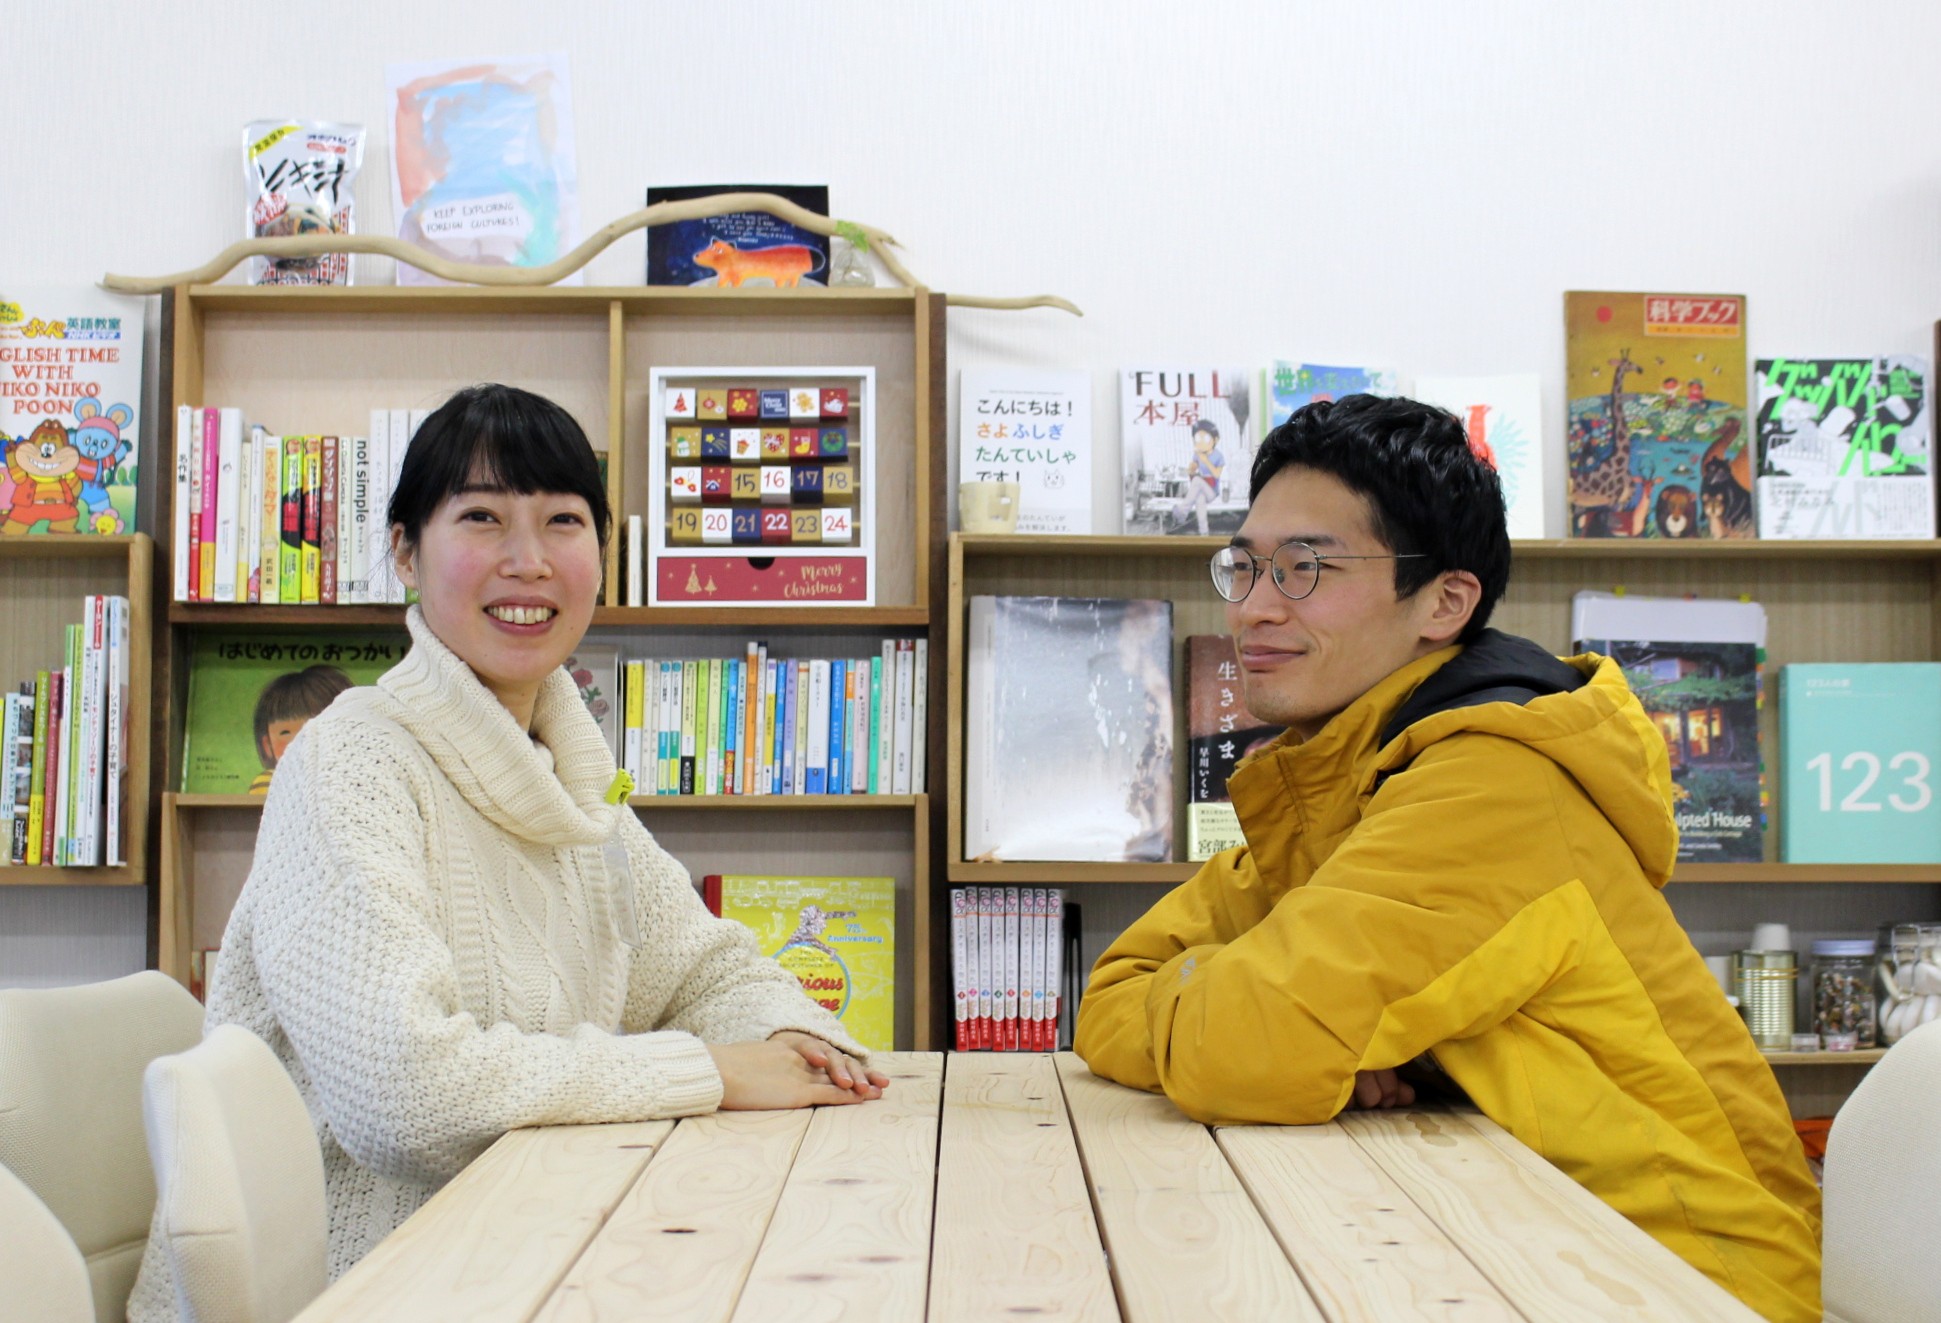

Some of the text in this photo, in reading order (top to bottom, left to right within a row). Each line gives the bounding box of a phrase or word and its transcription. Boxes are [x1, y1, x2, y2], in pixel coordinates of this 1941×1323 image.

[434, 202, 513, 218] KEEP EXPLORING
[427, 216, 519, 232] FOREIGN CULTURES!
[1651, 301, 1736, 322] 科学ブック
[0, 347, 119, 362] GLISH TIME
[12, 365, 73, 379] WITH
[0, 382, 100, 397] IKO NIKO
[1136, 370, 1232, 398] FULL
[13, 400, 73, 414] POON
[977, 399, 1073, 416] こんにちは！
[1134, 400, 1200, 426] 本屋
[976, 446, 1076, 464] たんていしゃ
[354, 440, 369, 523] not simple
[735, 474, 755, 492] 15
[764, 471, 784, 488] 16
[797, 471, 819, 487] 17
[827, 472, 848, 489] 18
[676, 513, 697, 531] 19
[705, 514, 727, 531] 20
[735, 515, 755, 532] 21
[765, 514, 788, 530] 22
[795, 516, 818, 533] 23
[825, 515, 848, 531] 24
[801, 563, 843, 579] Merry
[784, 577, 843, 598] Christmas
[218, 641, 407, 661] はじめてのおつかい
[1217, 661, 1238, 759] 生きざま
[1199, 747, 1209, 799] 早川いくを
[1806, 751, 1932, 812] 123
[1711, 811, 1752, 828] House
[1198, 839, 1244, 853] 宮部み
[828, 935, 883, 944] Anniversary
